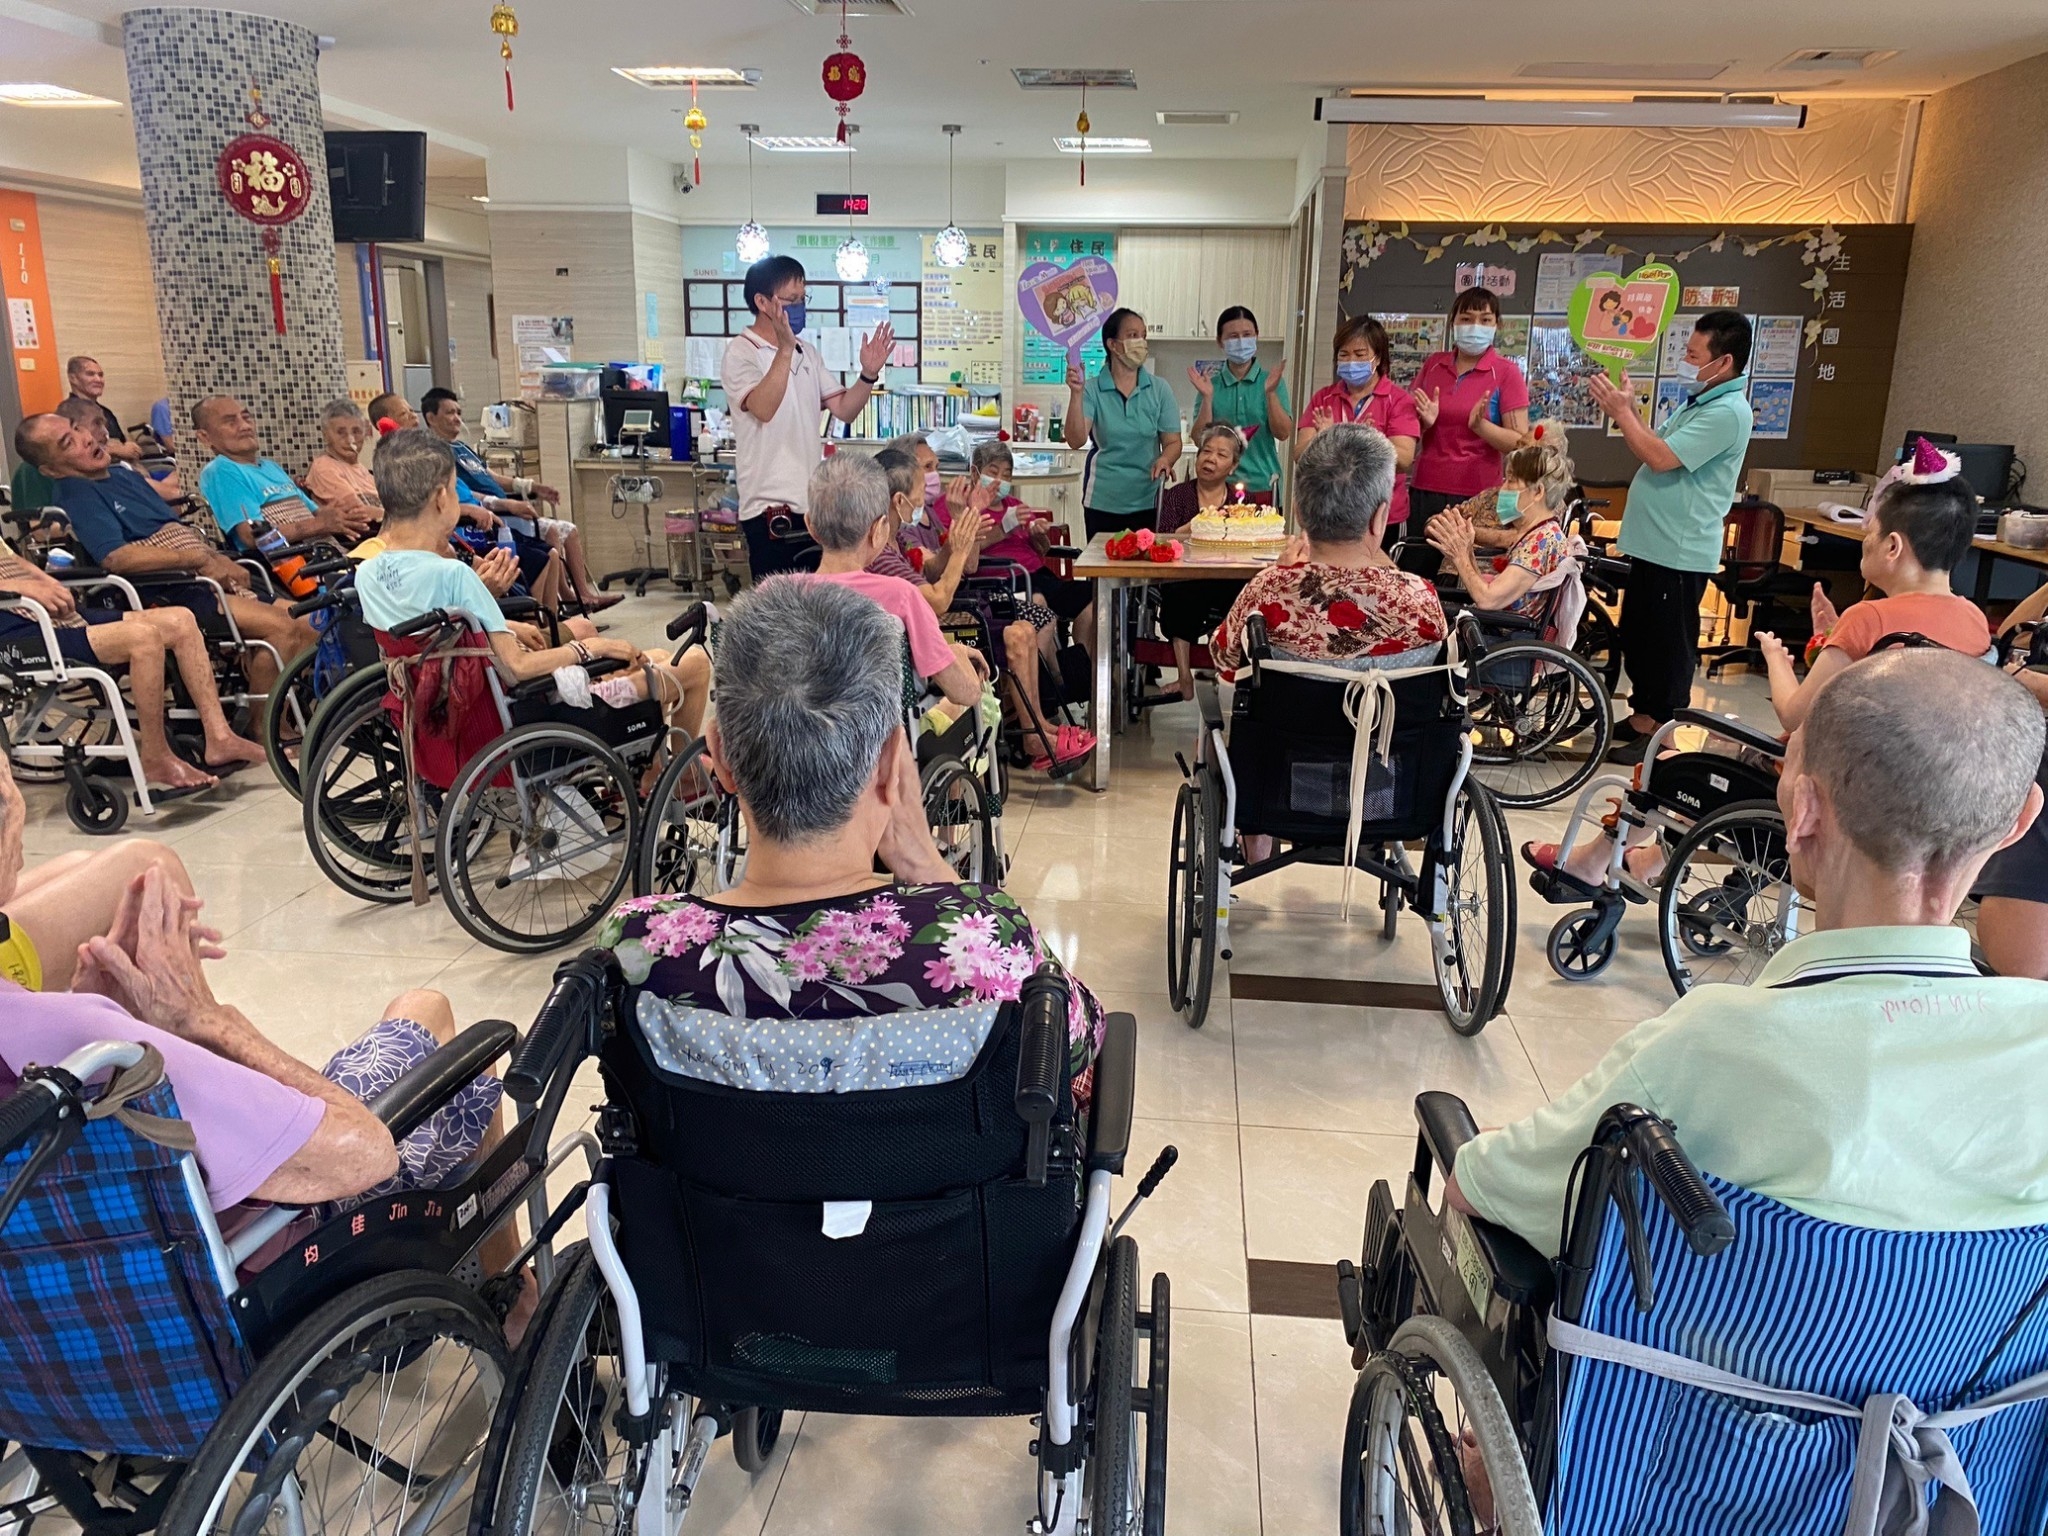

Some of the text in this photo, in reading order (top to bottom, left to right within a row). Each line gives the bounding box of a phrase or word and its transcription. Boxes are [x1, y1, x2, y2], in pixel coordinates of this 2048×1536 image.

[244, 150, 286, 193] 福
[18, 242, 29, 285] 110
[21, 656, 47, 665] soma
[626, 721, 647, 733] SOMA
[1676, 790, 1701, 809] SOMA
[388, 1202, 408, 1221] Jin
[424, 1199, 443, 1217] Jia
